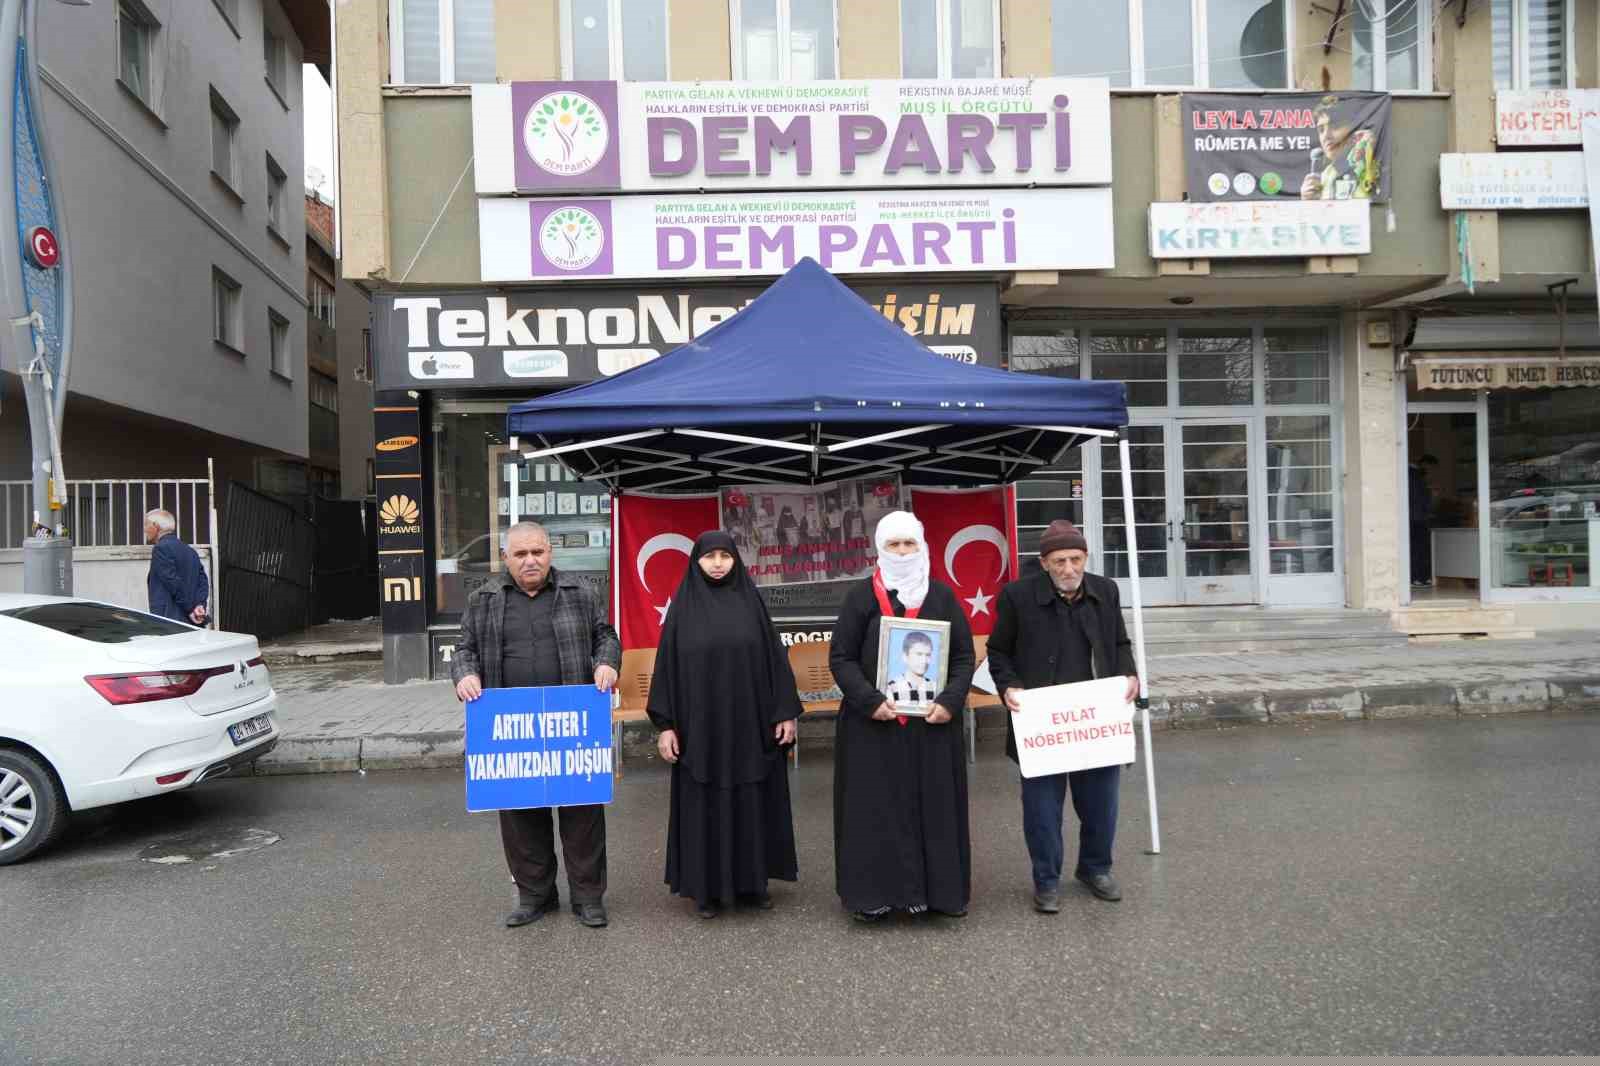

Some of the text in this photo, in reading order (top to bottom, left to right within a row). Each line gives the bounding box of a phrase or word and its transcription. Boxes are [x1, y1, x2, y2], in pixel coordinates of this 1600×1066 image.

[646, 100, 869, 115] HALKLARIN EŞİTLİK VE DEMOKRASİ PARTİSİ
[899, 98, 1032, 114] MUŞ İL ÖRGÜTÜ
[1193, 109, 1315, 130] LEYLA ZANA
[647, 94, 1072, 177] DEM PARTİ
[1195, 135, 1310, 152] RÛMETA ME YE!
[656, 215, 710, 225] HALKLARIN
[749, 214, 761, 224] VE
[764, 212, 817, 224] DEMOKRASİ
[821, 211, 857, 223] PARTİSİ
[656, 208, 1016, 270] DEM PARTİ
[393, 295, 755, 347] TeknoNe
[380, 525, 421, 535] HUAWEI
[492, 713, 535, 741] ARTIK
[538, 712, 579, 739] YETER
[1051, 707, 1096, 725] EVLAT
[1023, 722, 1132, 749] NÖBETİNDEYİZ
[468, 741, 612, 782] YAKAMIZDAN DÜŞÜN
